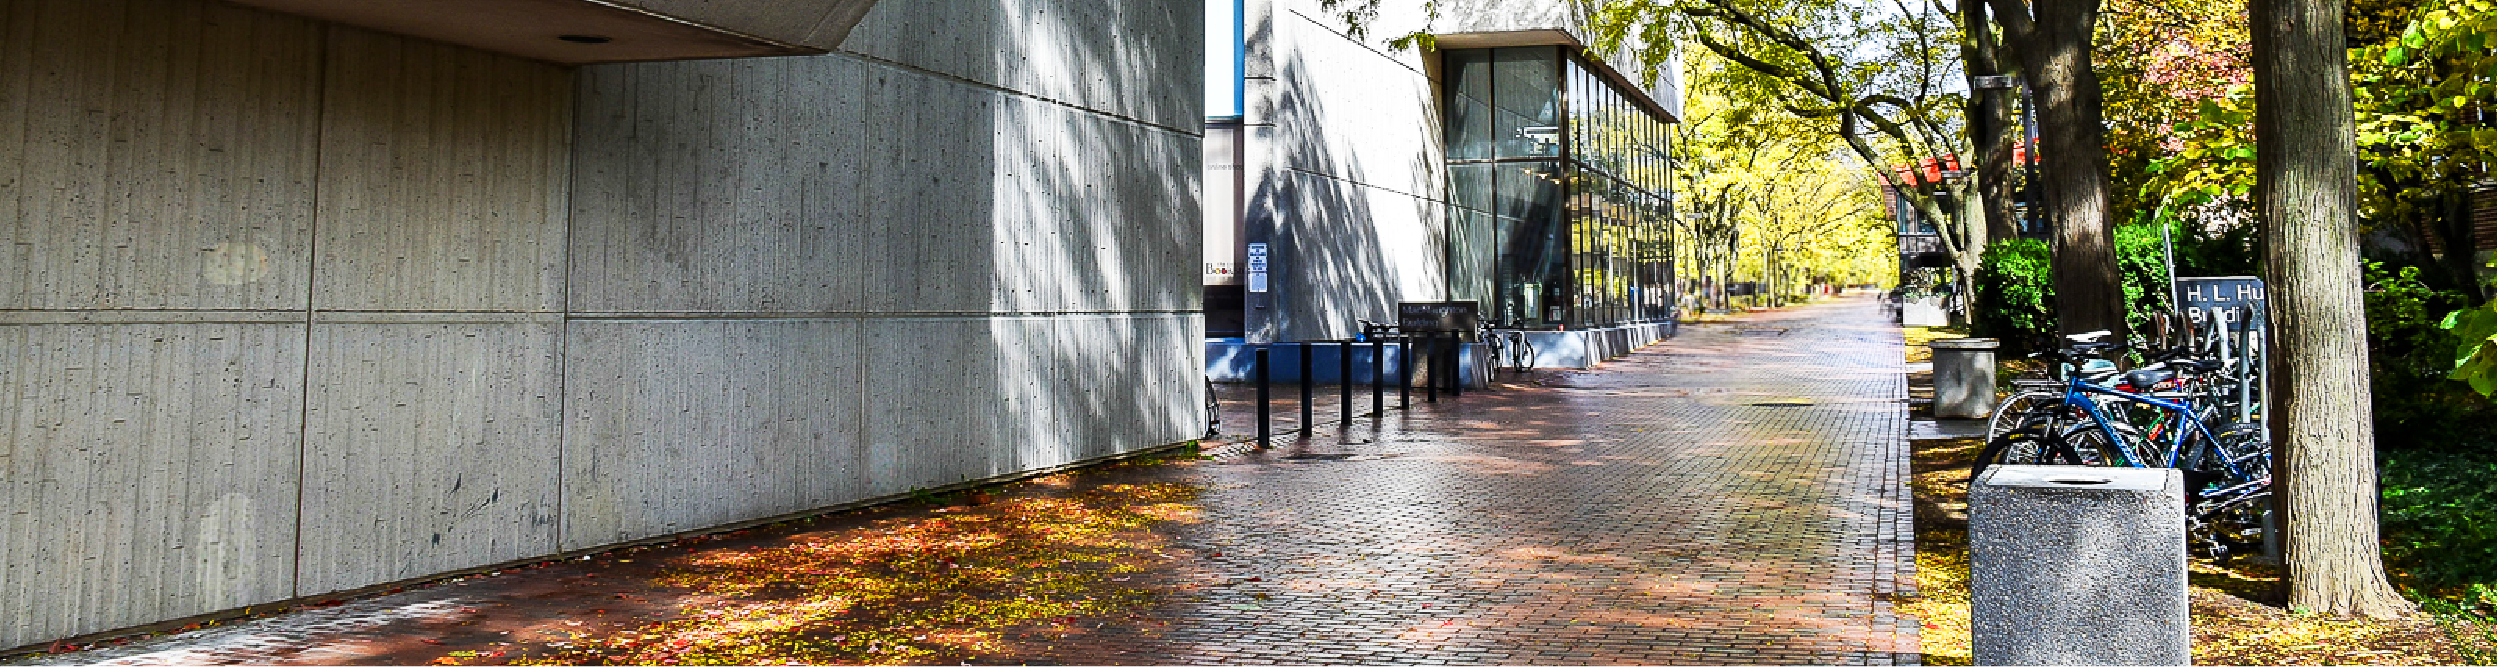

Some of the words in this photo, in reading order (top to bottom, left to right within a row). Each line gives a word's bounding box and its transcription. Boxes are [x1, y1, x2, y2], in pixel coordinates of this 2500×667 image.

[2187, 284, 2208, 302] H.
[2213, 284, 2231, 302] L.
[2236, 284, 2264, 301] Hu
